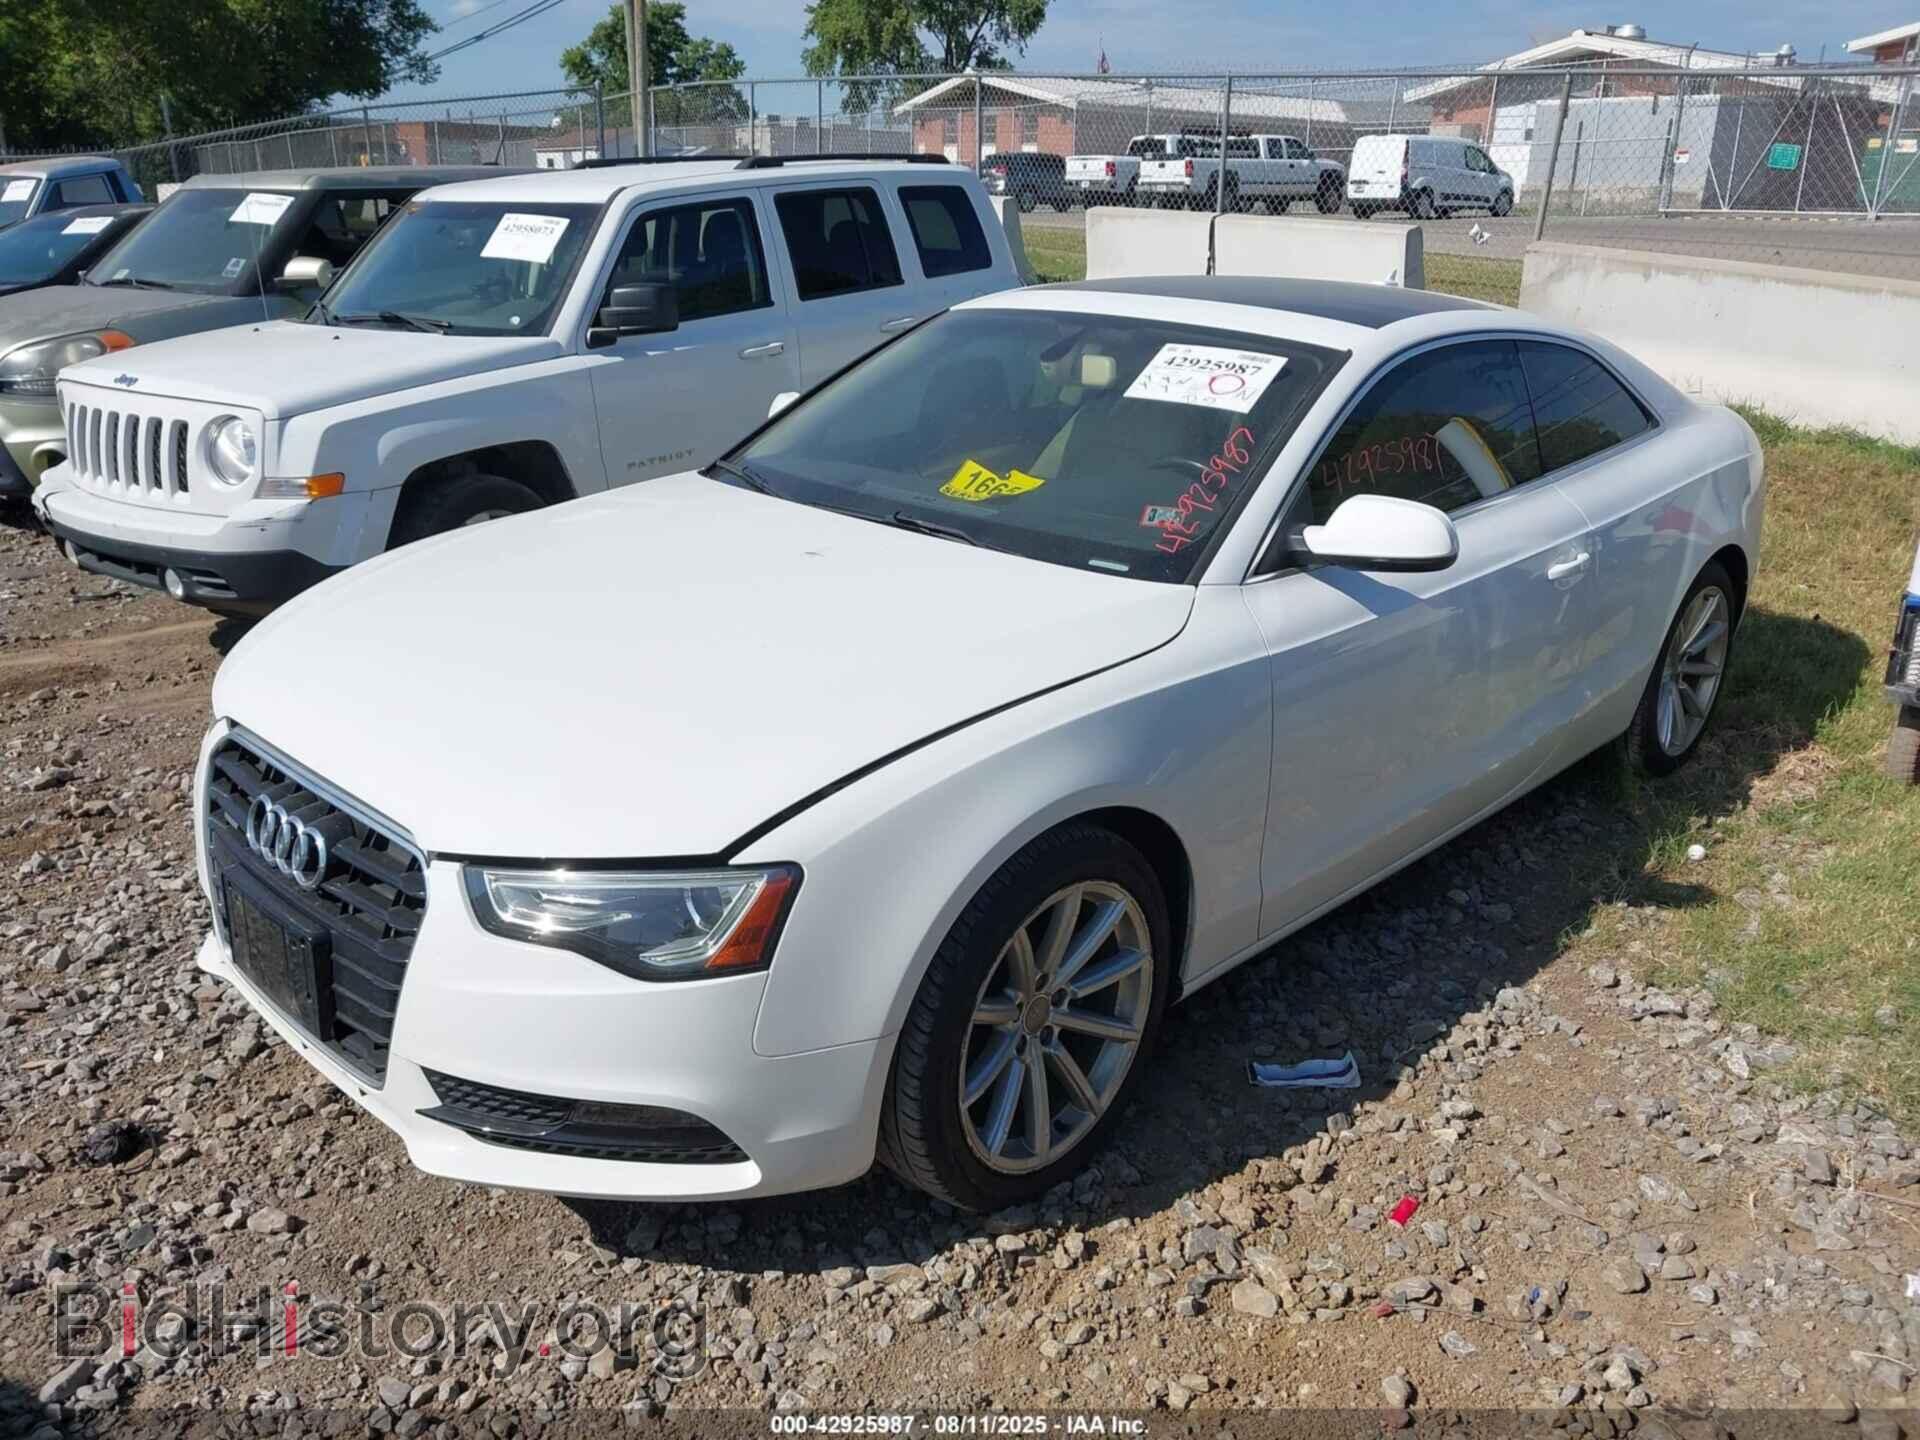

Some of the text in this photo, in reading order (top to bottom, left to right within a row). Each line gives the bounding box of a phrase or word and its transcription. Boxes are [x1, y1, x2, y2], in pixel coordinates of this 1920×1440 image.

[1164, 355, 1262, 376] 42925987
[626, 447, 696, 471] PATRIOT
[1322, 432, 1445, 495] 42925987
[1154, 427, 1255, 553] 42925987
